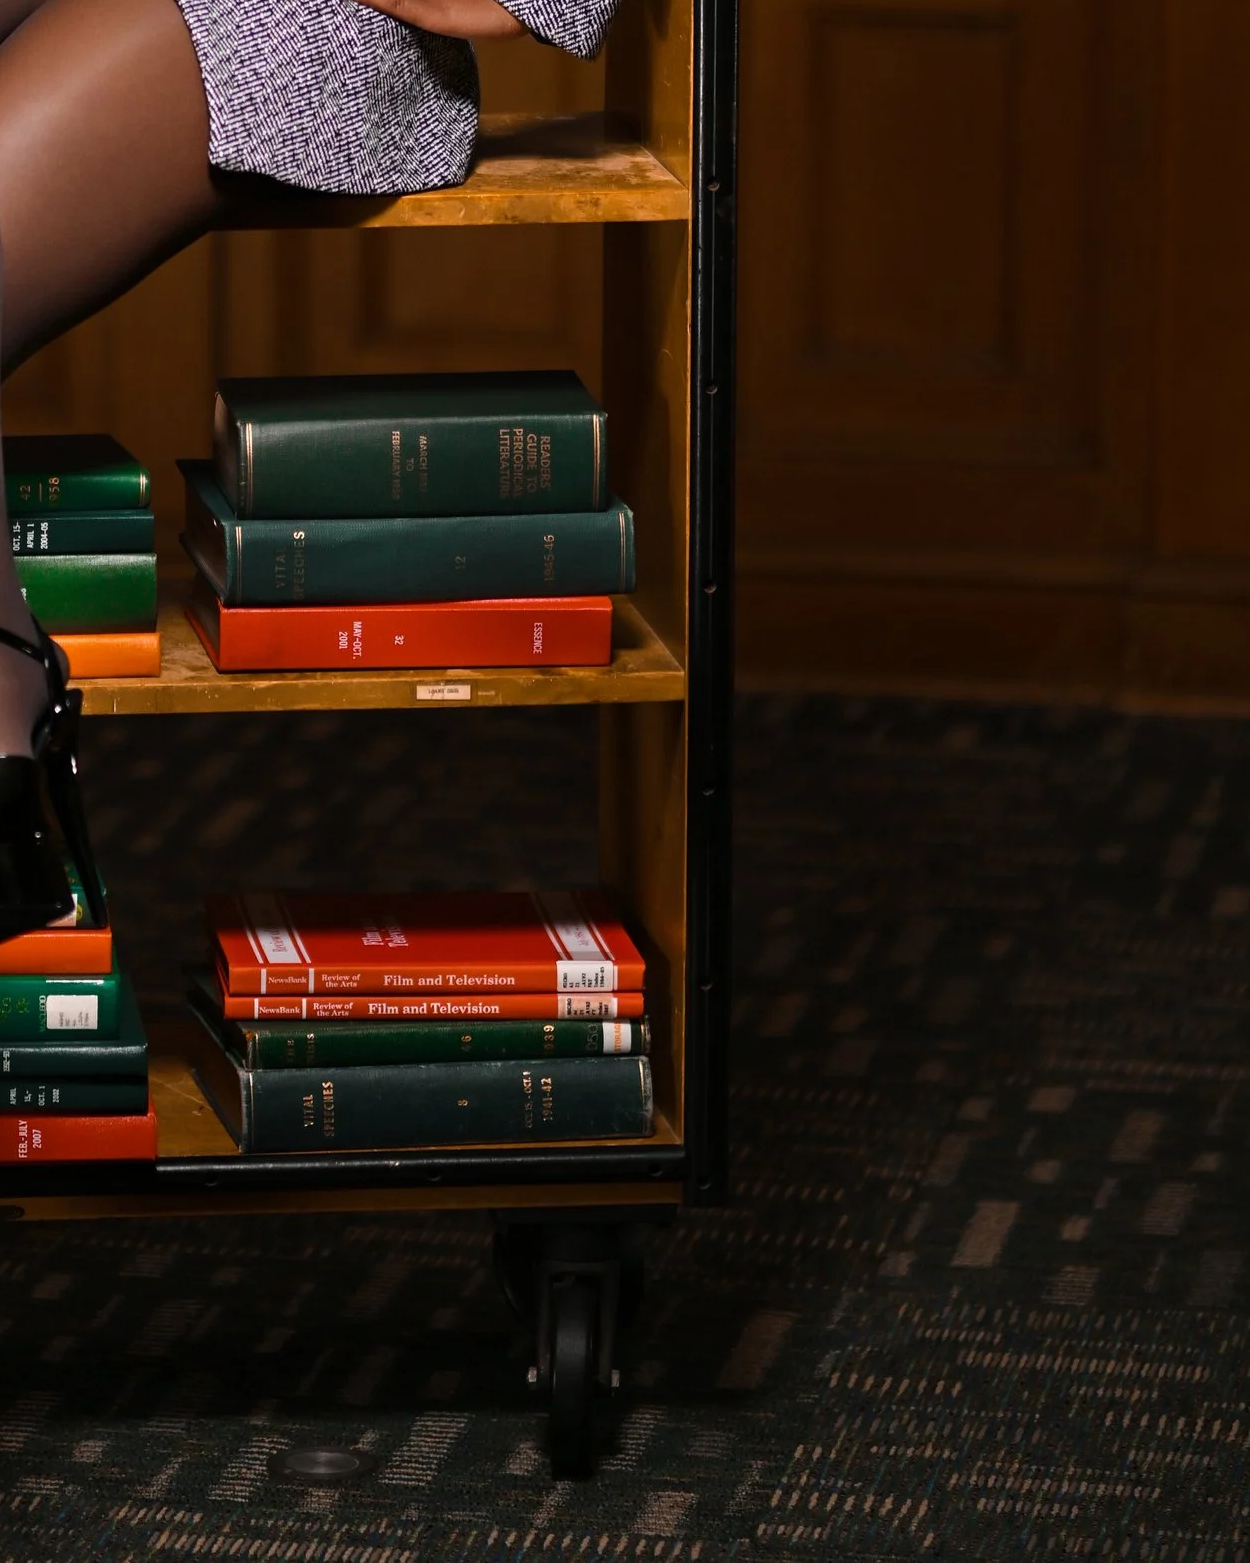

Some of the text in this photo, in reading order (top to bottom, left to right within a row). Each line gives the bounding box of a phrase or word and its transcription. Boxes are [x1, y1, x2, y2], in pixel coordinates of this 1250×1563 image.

[391, 430, 401, 477] FEBRUARY
[419, 434, 428, 470] MARCH
[499, 428, 510, 499] LITERATURE
[513, 428, 524, 499] PERIODICAL
[527, 433, 537, 494] GUIDE TO
[406, 458, 415, 472] TO
[20, 485, 31, 501] 42
[49, 477, 60, 507] 958
[13, 534, 21, 551] OCT.
[40, 522, 48, 550] 2004-05
[293, 531, 305, 600] SPEECHES
[454, 555, 466, 570] 12
[339, 631, 348, 650] 2001
[353, 621, 362, 660] MAY-OCT.
[394, 635, 404, 646] 32
[533, 622, 543, 655] ESSENCE
[268, 976, 307, 985] NewsBank
[321, 973, 361, 982] Review of
[325, 980, 357, 989] the Arts
[384, 974, 515, 987] Film and Television
[259, 1006, 300, 1015] NewsBank
[313, 1001, 354, 1011] Review of
[317, 1009, 349, 1018] the Arts
[368, 1003, 500, 1015] Film and Television
[543, 1024, 555, 1054] 939
[322, 1081, 335, 1138] SPEECHES
[541, 1077, 553, 1121] 1941-42
[303, 1094, 314, 1128] VITAL
[18, 1119, 28, 1158] FEB.-JULY
[33, 1129, 42, 1148] 2007
